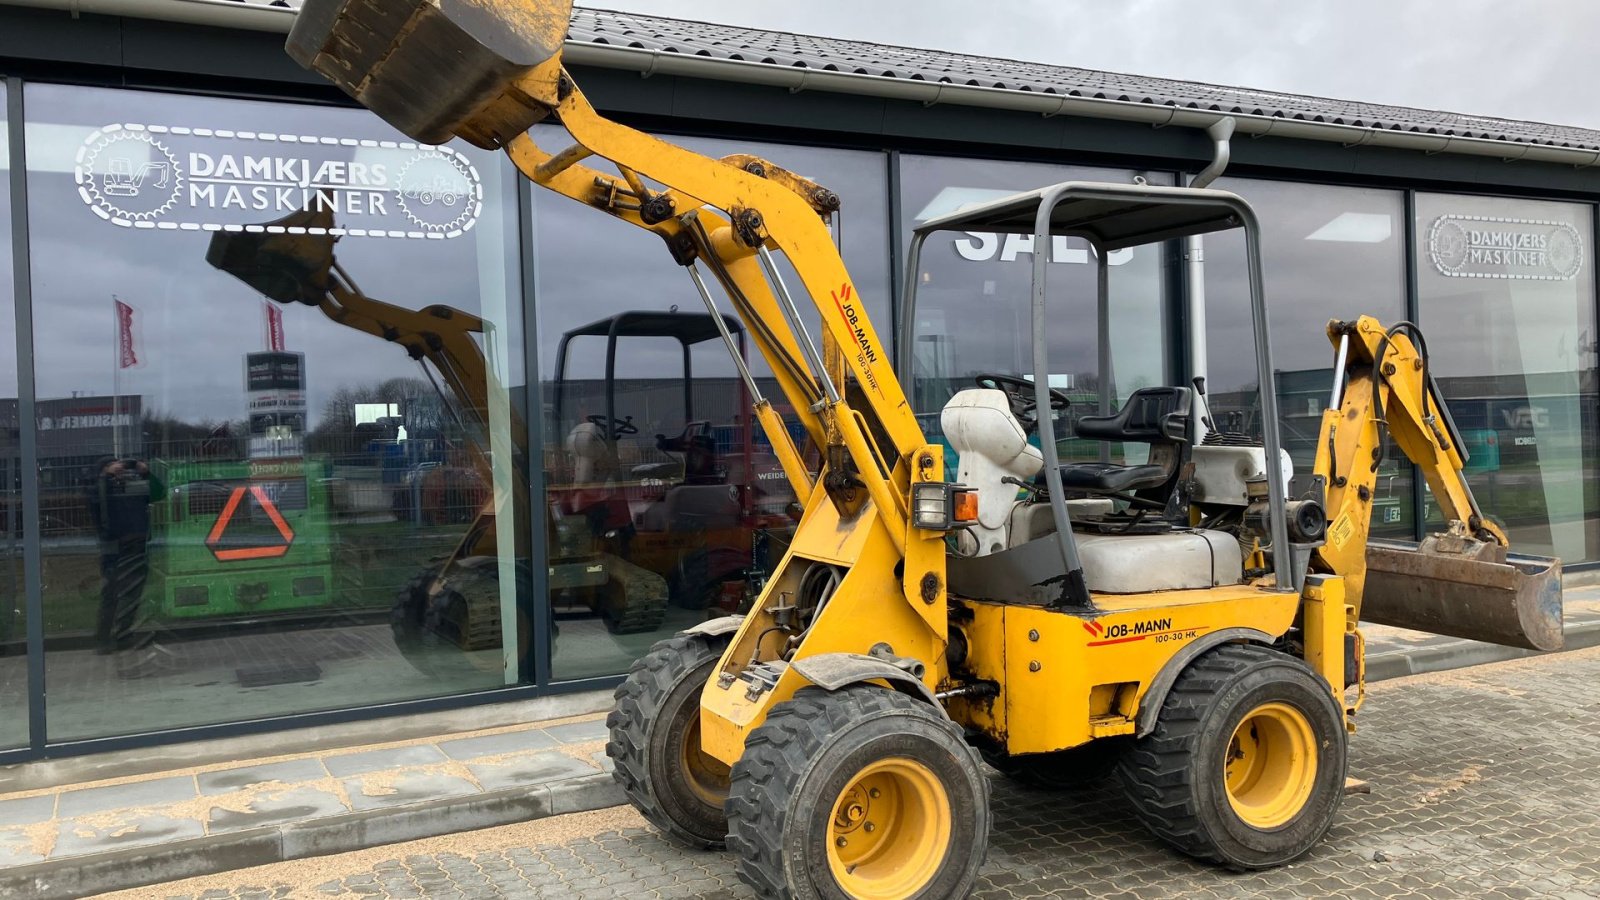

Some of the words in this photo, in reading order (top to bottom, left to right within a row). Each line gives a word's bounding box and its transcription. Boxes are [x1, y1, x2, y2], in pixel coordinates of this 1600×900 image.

[189, 152, 388, 188] DAMKJÆRS
[189, 183, 388, 215] MASKINER
[1471, 230, 1547, 250] DAMKJÆRS
[1471, 250, 1547, 266] MASKINER
[842, 303, 877, 364] JOB-MANN
[1104, 618, 1172, 639] JOB-MANN
[1155, 632, 1183, 643] 100-30
